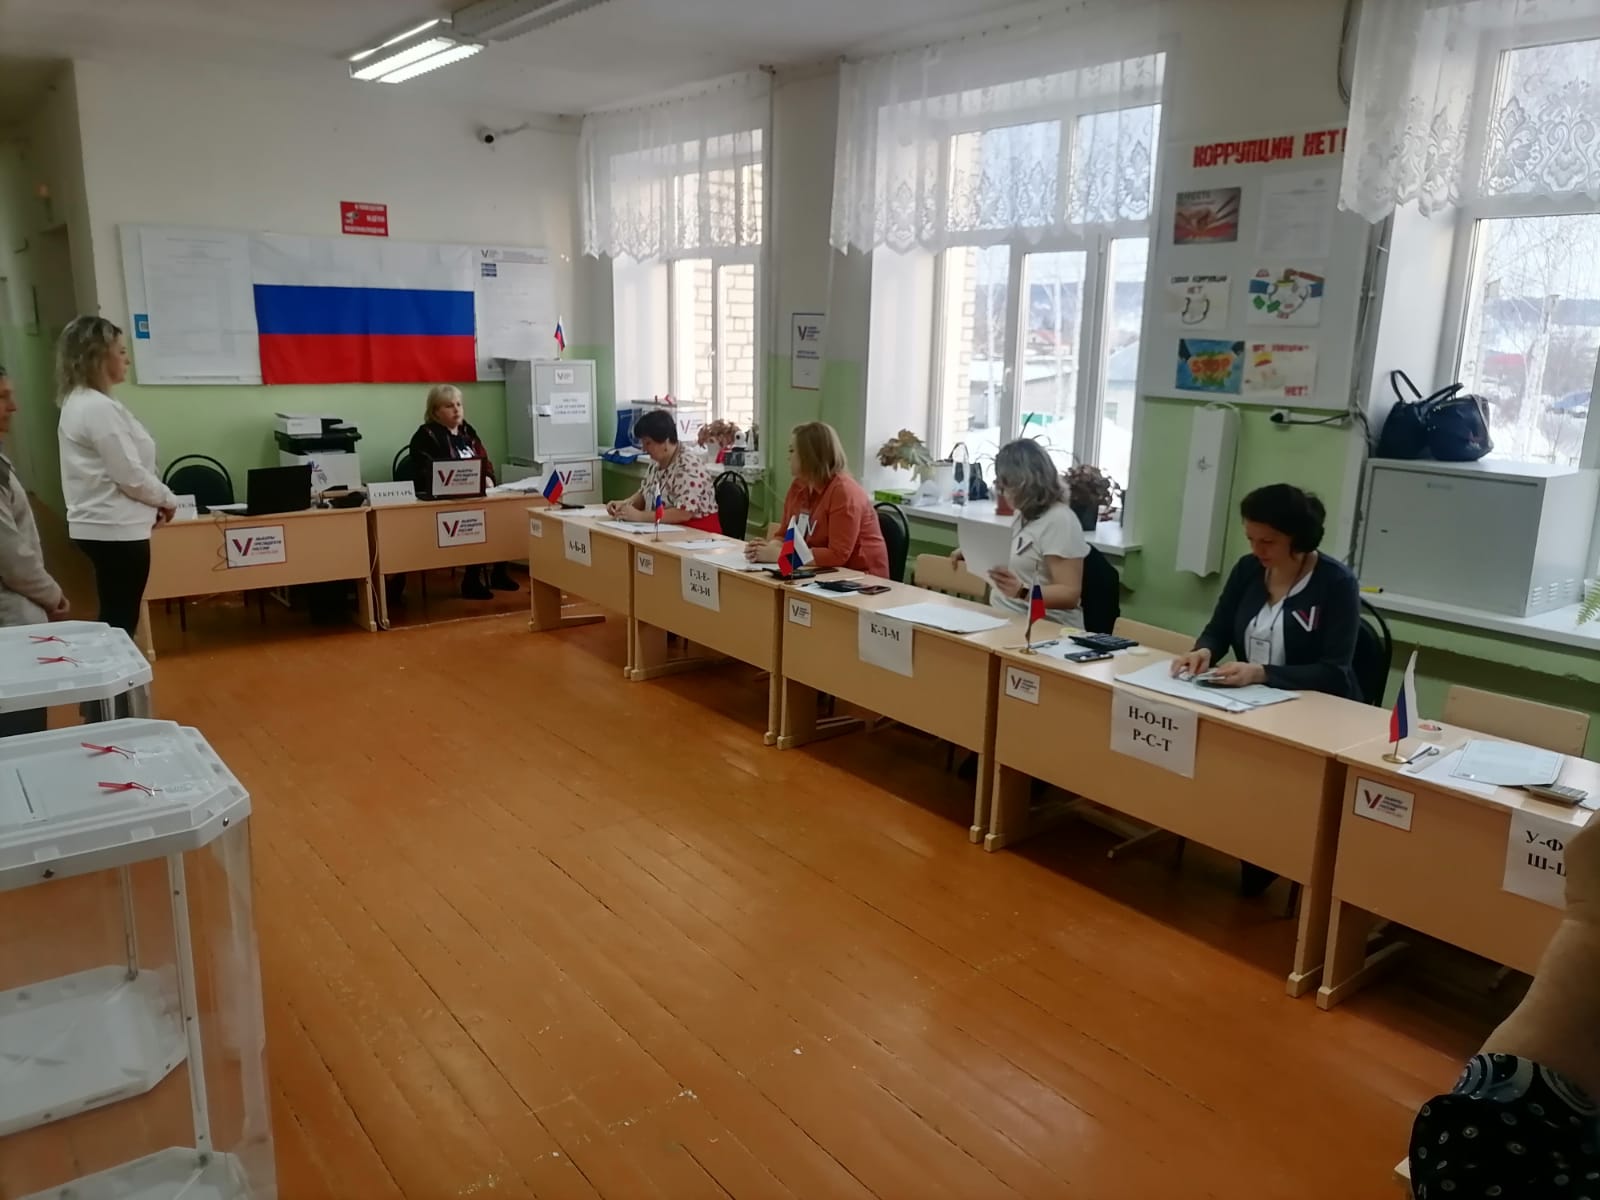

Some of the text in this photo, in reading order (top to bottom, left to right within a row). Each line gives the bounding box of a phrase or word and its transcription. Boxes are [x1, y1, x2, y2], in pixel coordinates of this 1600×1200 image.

[1193, 136, 1295, 168] КОРРУПЦИИ
[870, 623, 901, 642] К-Л-М
[1128, 705, 1180, 731] Н-О-П-
[1132, 727, 1172, 752] Р-С-Т
